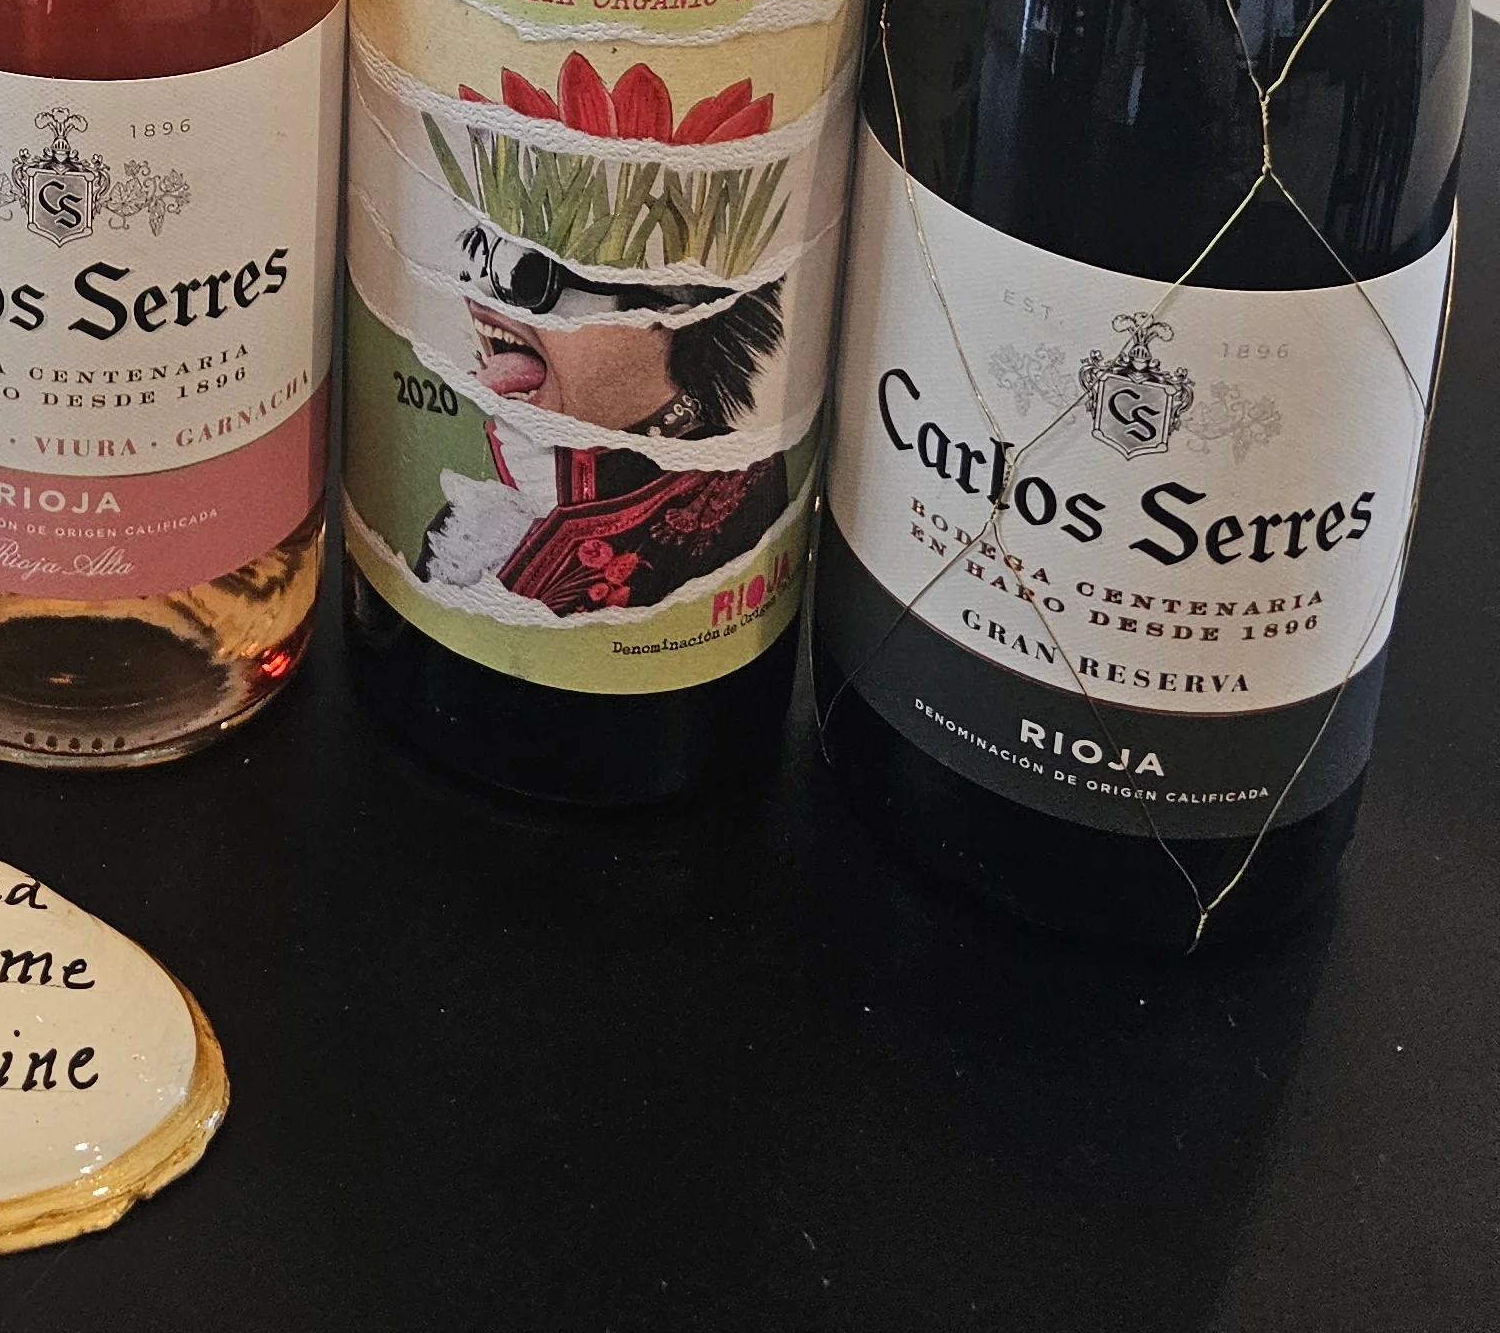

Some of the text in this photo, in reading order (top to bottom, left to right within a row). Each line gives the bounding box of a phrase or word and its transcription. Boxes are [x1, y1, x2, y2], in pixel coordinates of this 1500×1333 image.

[130, 118, 191, 139] 1896
[67, 243, 290, 341] Serres
[28, 343, 249, 384] CENTENARIA
[1221, 342, 1289, 359] 1896
[34, 436, 138, 458] VIURA
[175, 368, 310, 449] GARNACHA
[41, 390, 155, 408] DESDE
[176, 366, 246, 400] 1896
[393, 370, 458, 416] 2020
[877, 368, 1377, 566] Carlos Serres
[26, 523, 47, 536] DE
[54, 526, 117, 538] ORIGEN
[125, 507, 218, 535] CALIFICADA
[61, 545, 136, 577] Alta
[909, 521, 1318, 642] EN HARO DESDE 1896
[910, 496, 1324, 617] BODEGA CENTENARIA
[612, 627, 722, 656] Denominación
[723, 623, 737, 638] de
[962, 608, 1250, 694] GRAN RESERVA
[914, 698, 1269, 804] DENOMINACIÓN DE ORIGEN CALIFICADA
[1019, 718, 1165, 777] RIOJA
